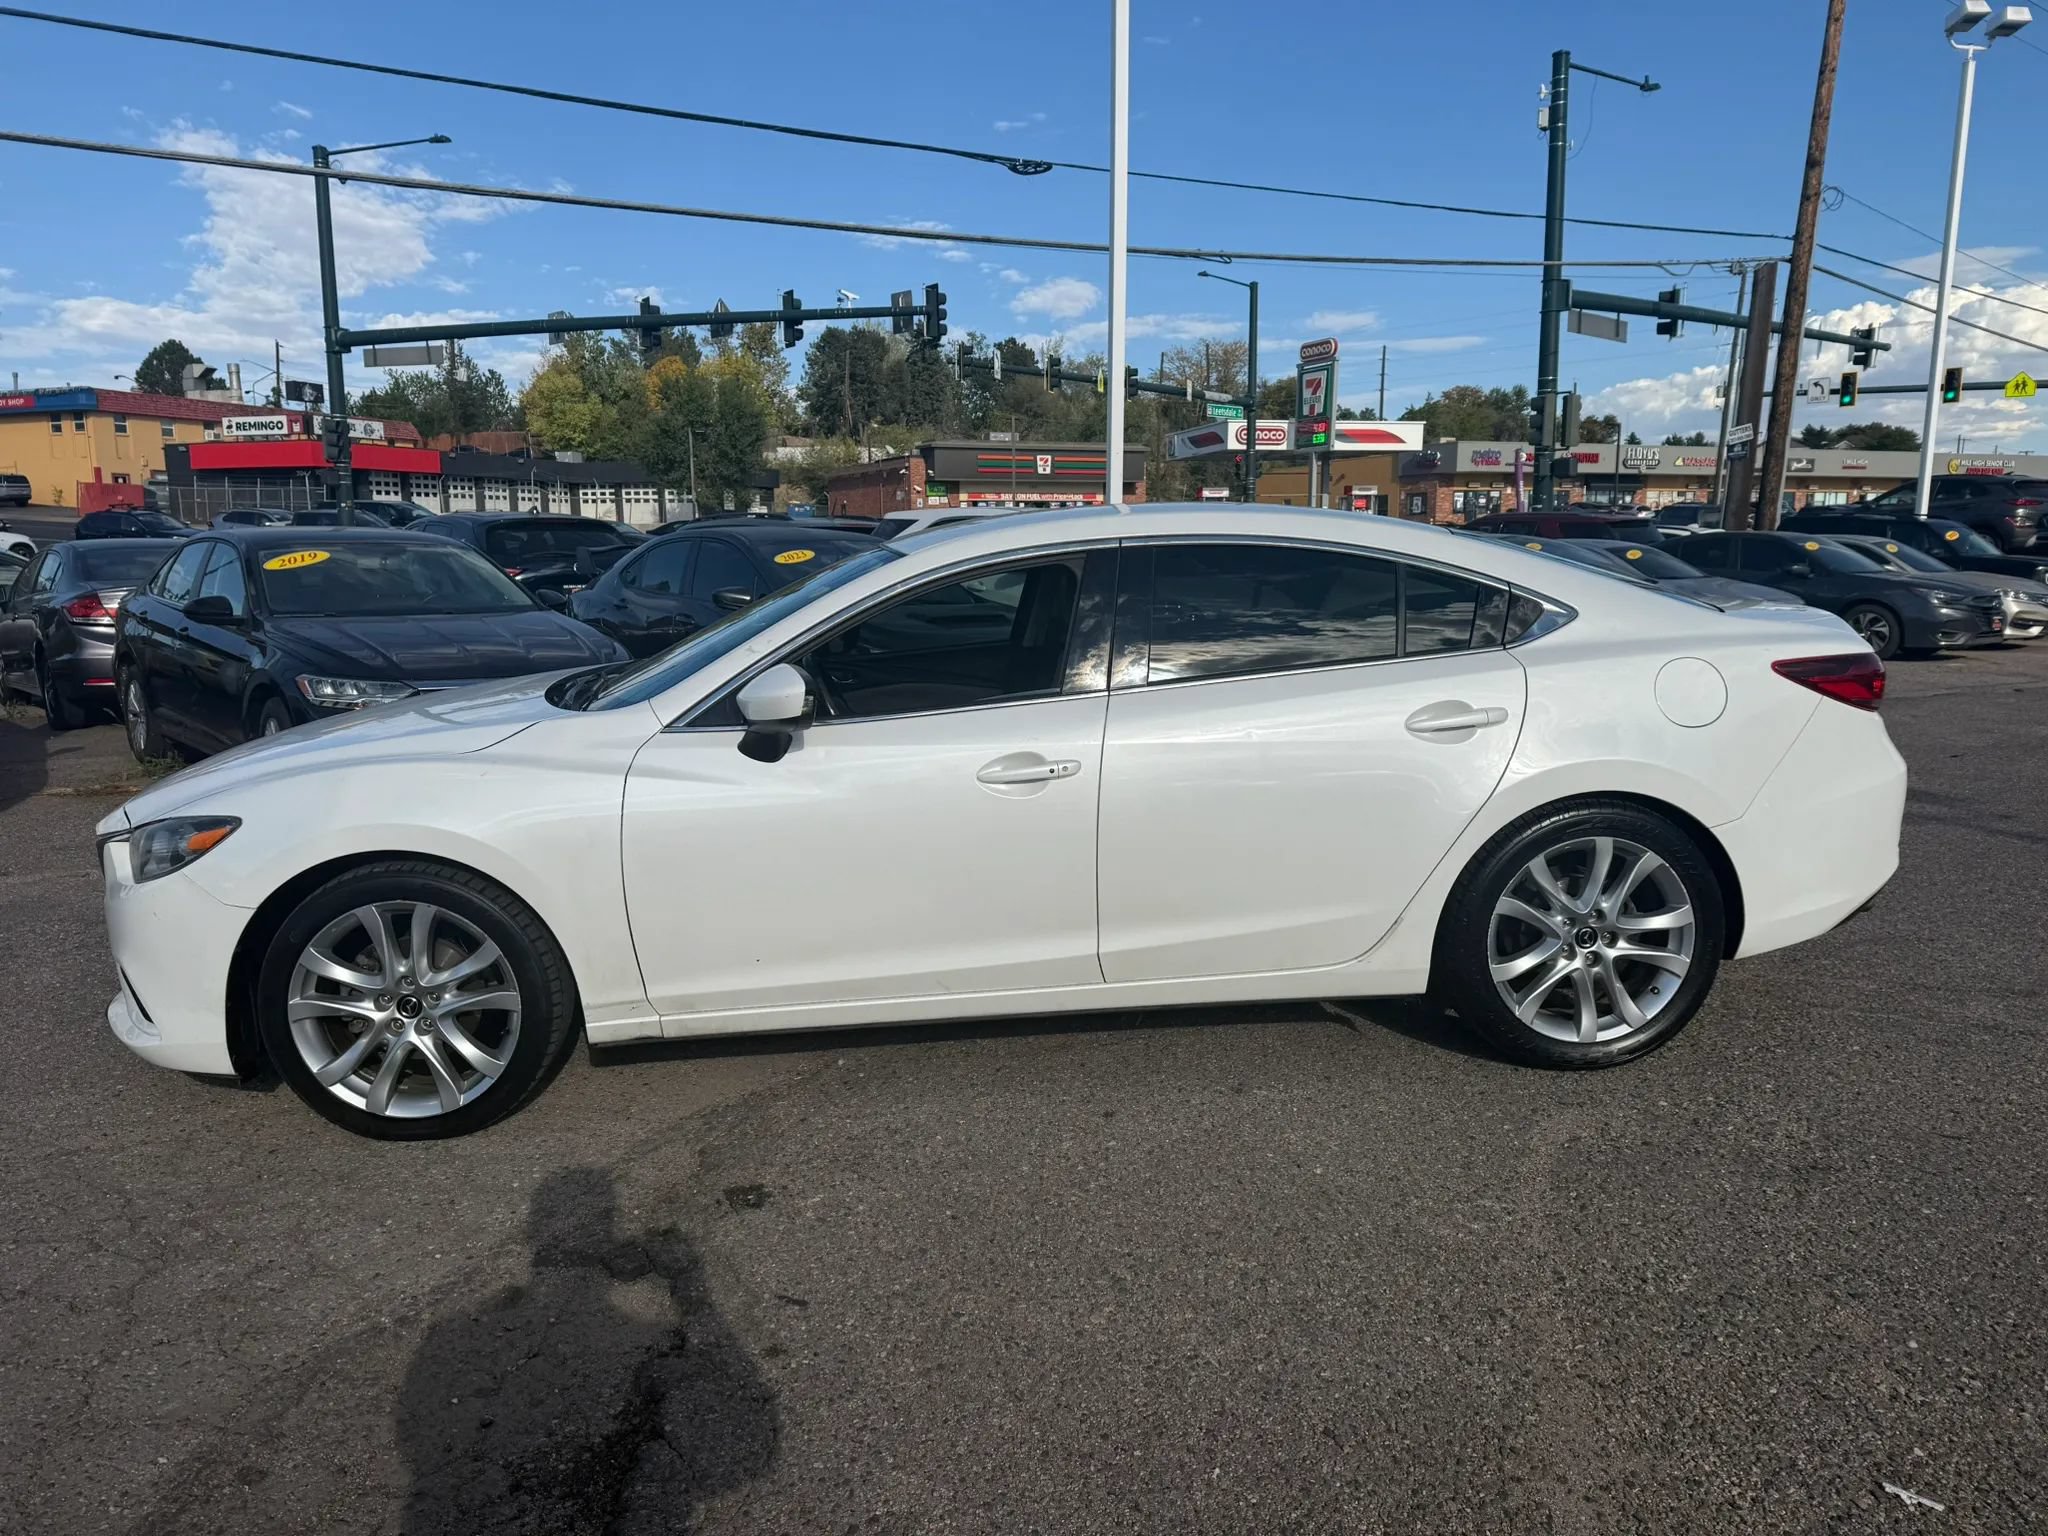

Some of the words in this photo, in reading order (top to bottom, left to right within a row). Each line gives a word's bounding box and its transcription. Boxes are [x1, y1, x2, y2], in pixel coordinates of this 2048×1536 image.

[8, 398, 24, 406] SHOP
[1212, 406, 1236, 417] Leetsdale
[235, 420, 284, 432] REMINGO
[1240, 430, 1284, 440] cnoco
[1627, 447, 1660, 459] FLOYD'S
[1684, 456, 1717, 467] MASSAG
[279, 551, 318, 568] 2019
[782, 550, 808, 562] 2023
